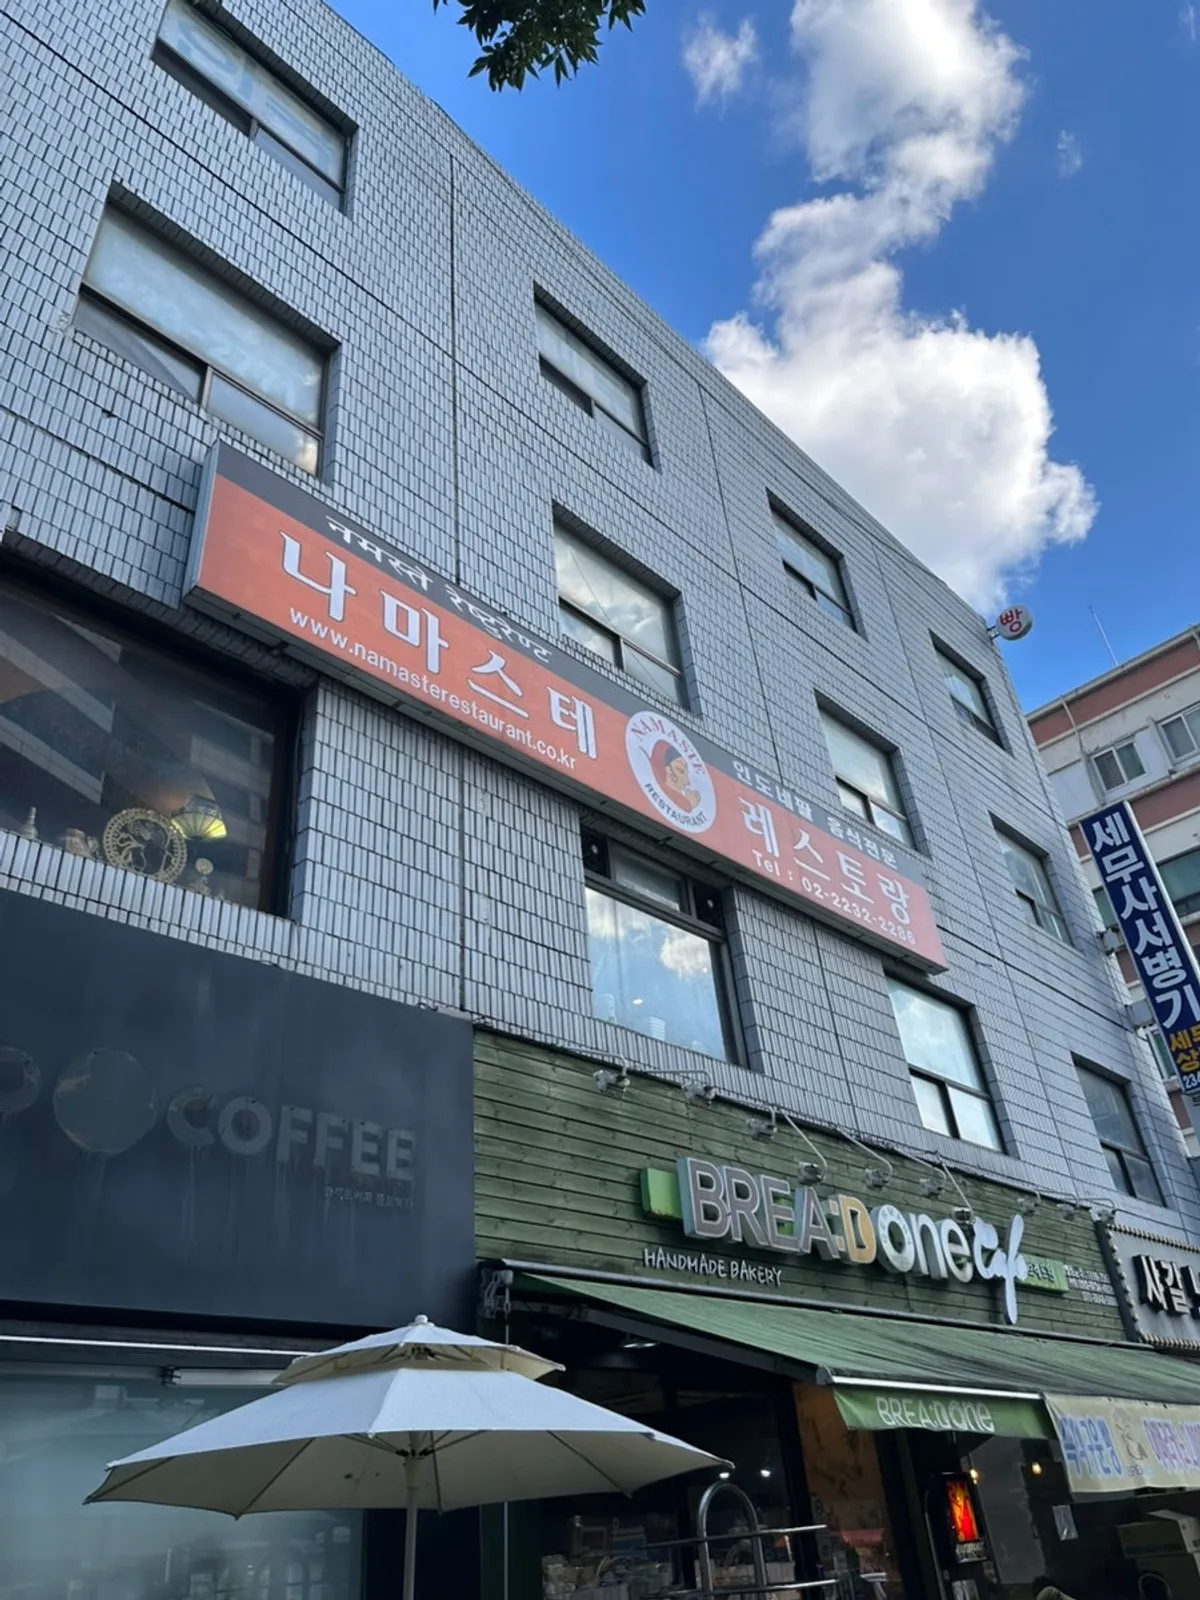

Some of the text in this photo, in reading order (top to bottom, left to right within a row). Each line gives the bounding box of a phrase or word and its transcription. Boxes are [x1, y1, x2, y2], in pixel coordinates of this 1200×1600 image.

[326, 515, 433, 591] नमस्ते
[279, 531, 597, 760] 나마스테
[1000, 608, 1023, 633] 빵
[289, 608, 577, 769] www.namasterestaurant.co.kr
[631, 716, 706, 776] NAMASTE
[645, 782, 708, 827] RESTAURANT
[738, 796, 910, 925] 레스토랑
[827, 816, 898, 870] 음식전문
[167, 1086, 415, 1181] COFFEE
[644, 1247, 782, 1287] HANDMADE BAKERY
